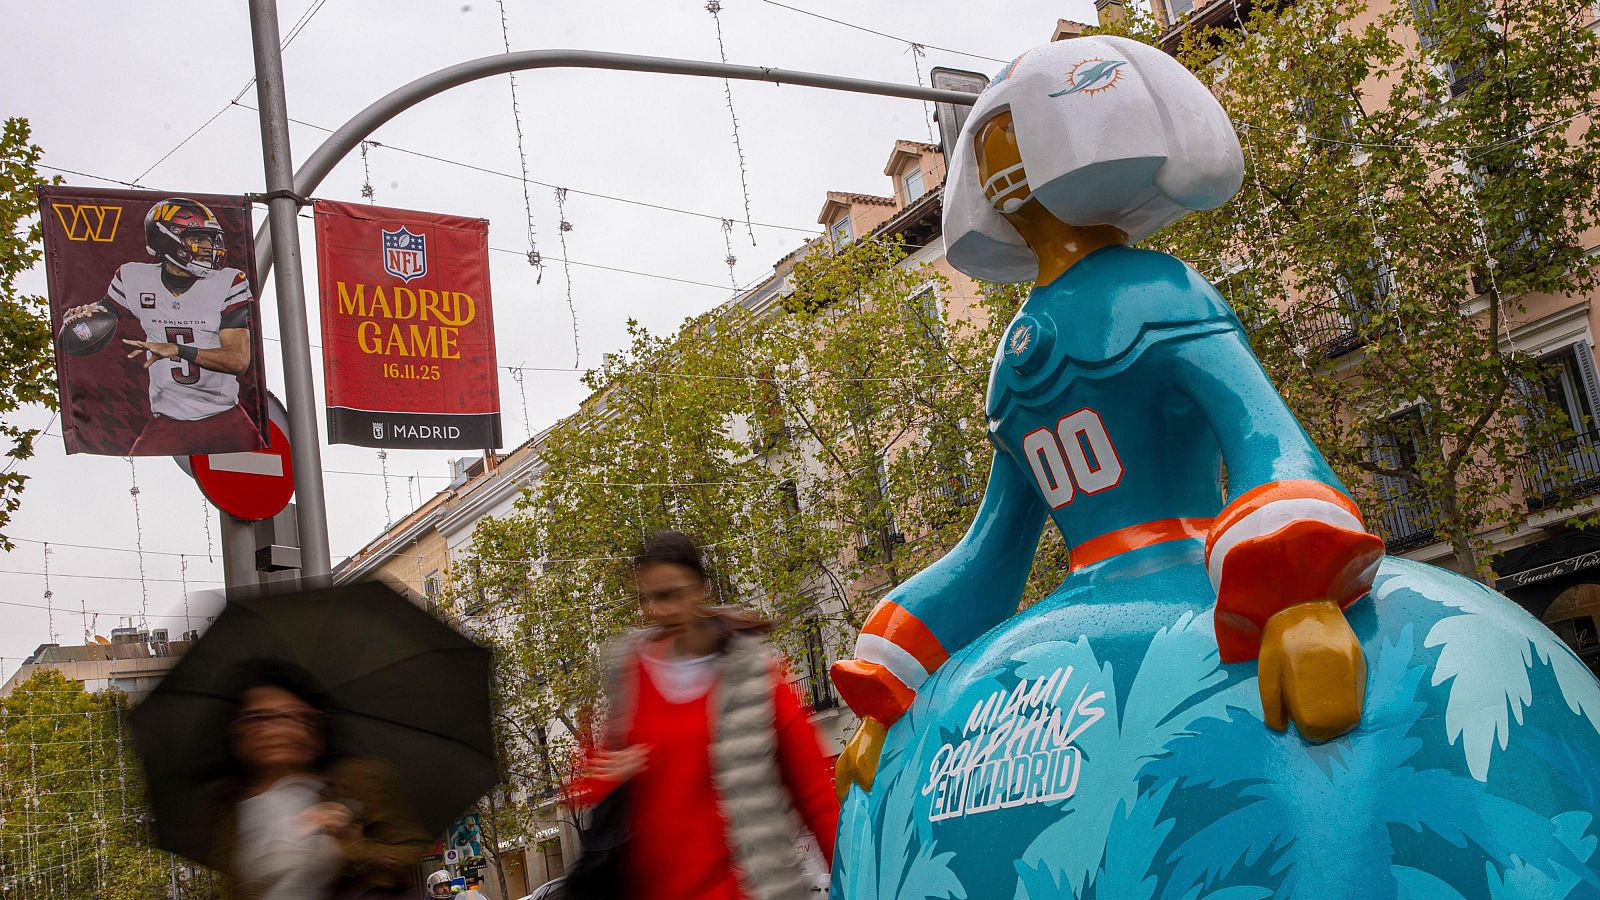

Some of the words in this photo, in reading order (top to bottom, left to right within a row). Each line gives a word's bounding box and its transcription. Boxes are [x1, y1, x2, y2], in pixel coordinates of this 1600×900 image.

[387, 249, 423, 275] NFL
[336, 281, 476, 326] MADRID
[164, 326, 201, 385] 5
[357, 320, 461, 360] GAME
[382, 362, 442, 381] 16.11.25
[393, 424, 461, 440] MADRID
[1021, 406, 1126, 511] 00
[962, 665, 1074, 739] MIAMI
[921, 682, 1106, 797] DOLPHINS
[928, 772, 968, 822] EN
[965, 745, 1082, 815] MADRID
